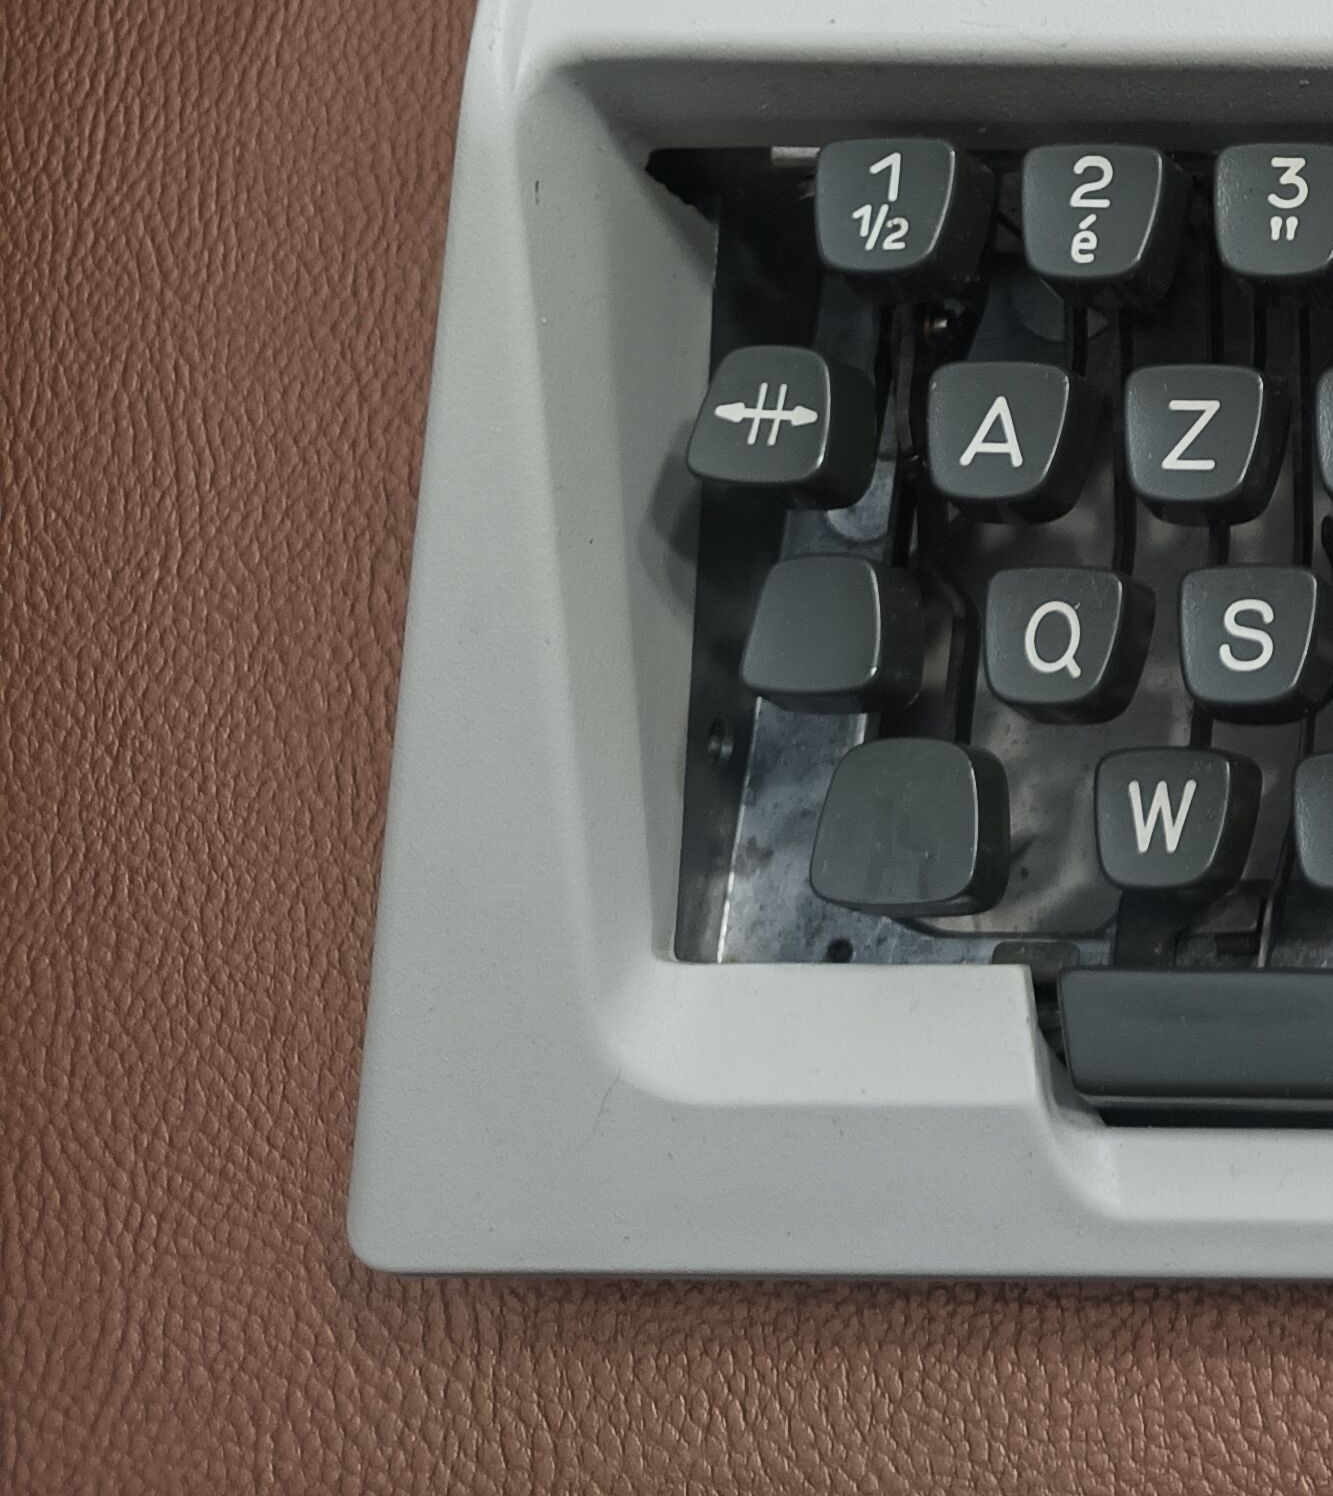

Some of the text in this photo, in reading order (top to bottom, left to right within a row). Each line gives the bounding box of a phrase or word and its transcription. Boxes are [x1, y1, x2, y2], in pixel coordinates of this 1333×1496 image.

[869, 152, 901, 202] 1
[1070, 155, 1113, 208] 2
[1267, 157, 1309, 209] 3
[1071, 214, 1098, 264] é
[959, 396, 1023, 467] A
[1161, 399, 1220, 470] Z
[1024, 601, 1081, 678] Q
[1219, 599, 1274, 671] S
[1128, 780, 1197, 853] W
